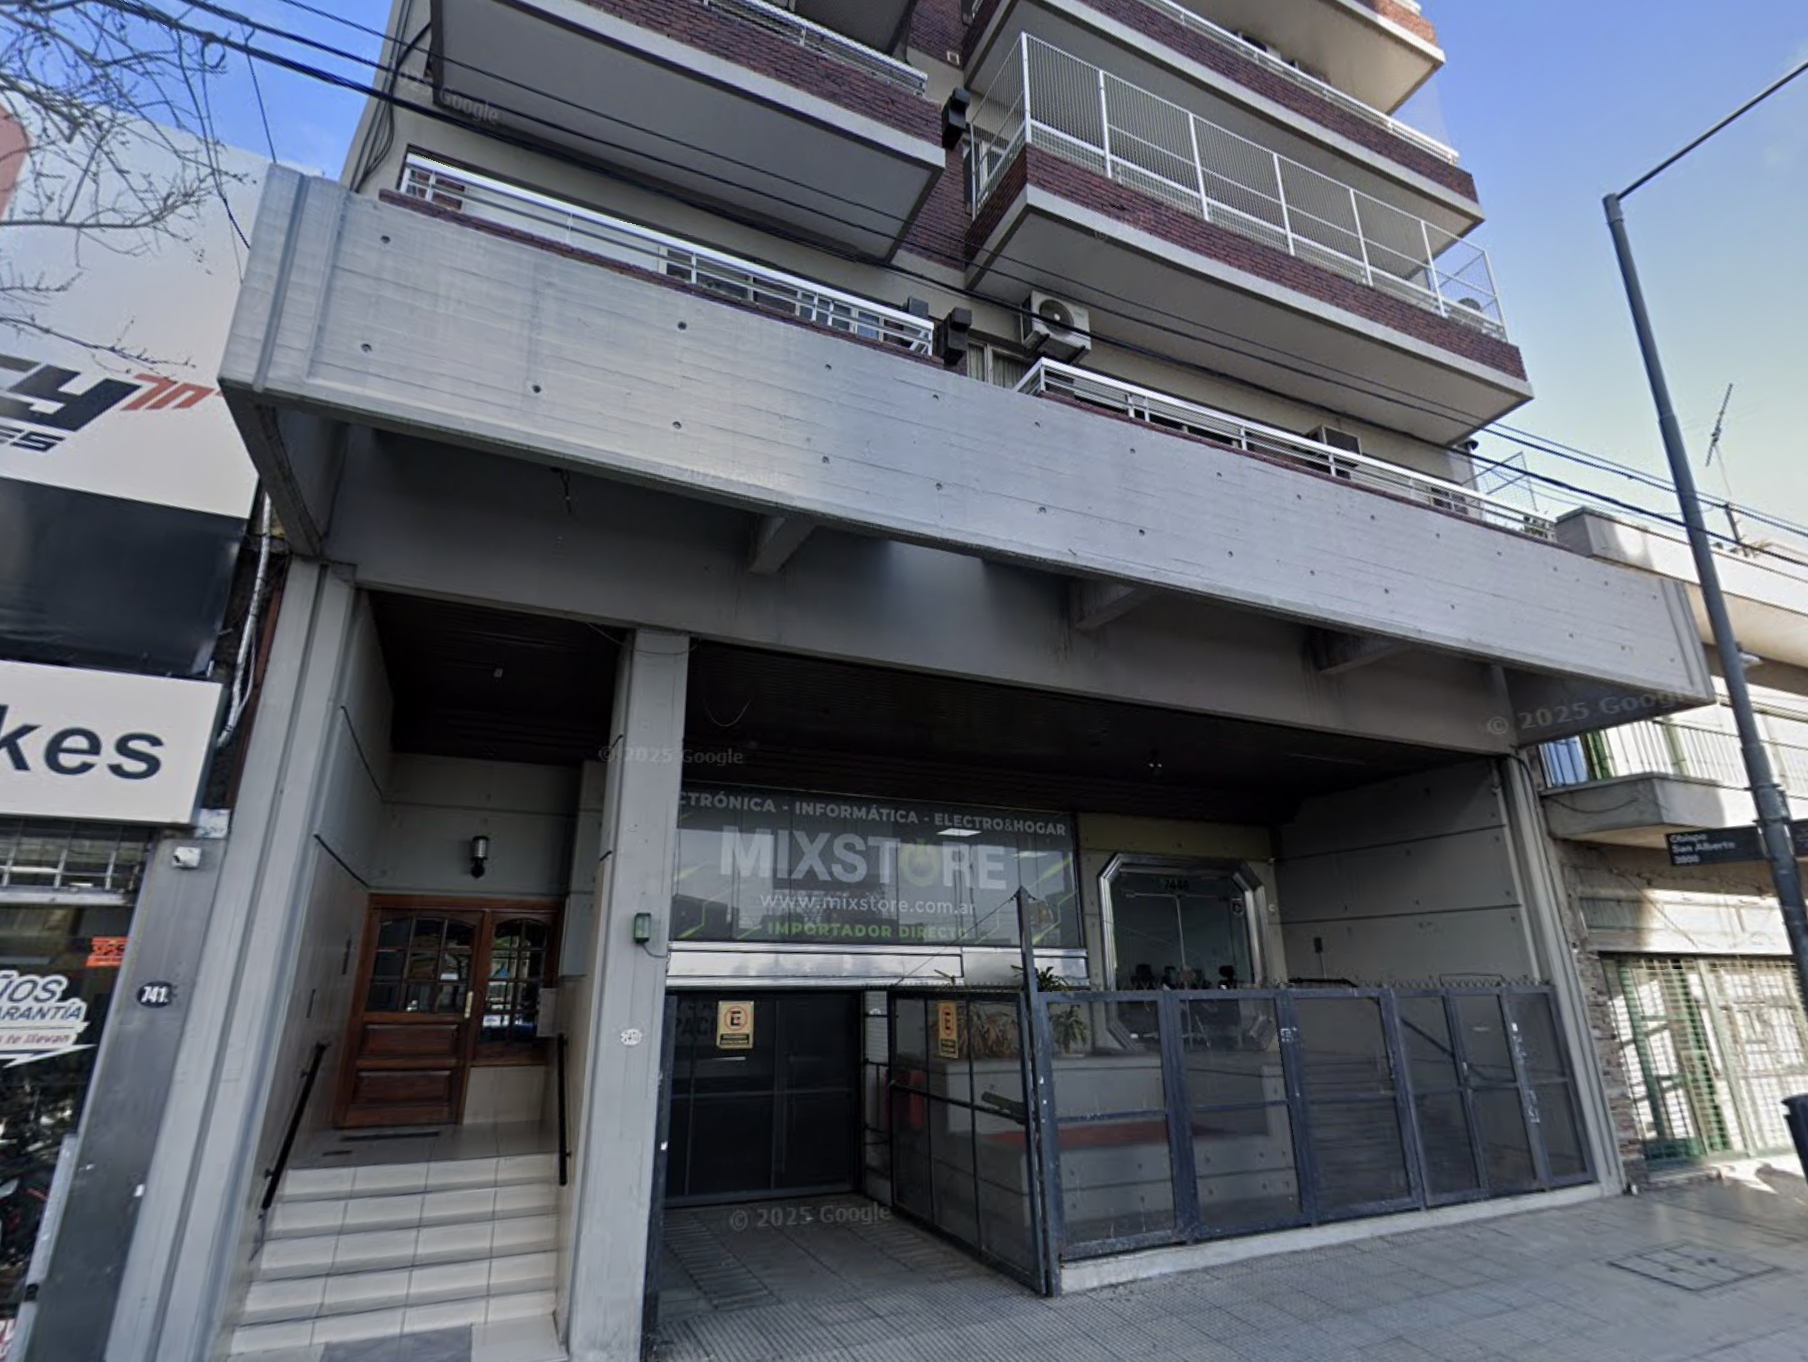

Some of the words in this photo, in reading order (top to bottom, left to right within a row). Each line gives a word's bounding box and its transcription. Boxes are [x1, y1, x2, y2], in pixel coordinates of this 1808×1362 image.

[795, 800, 919, 824] INFORMÁTICA
[934, 812, 1066, 836] ELECTRO&HOGAR
[720, 825, 1007, 890] MIXSTORE
[760, 891, 976, 917] www.mixstore.com.ar
[767, 920, 892, 938] IMPORTADOR
[898, 925, 968, 940] DIRECTO
